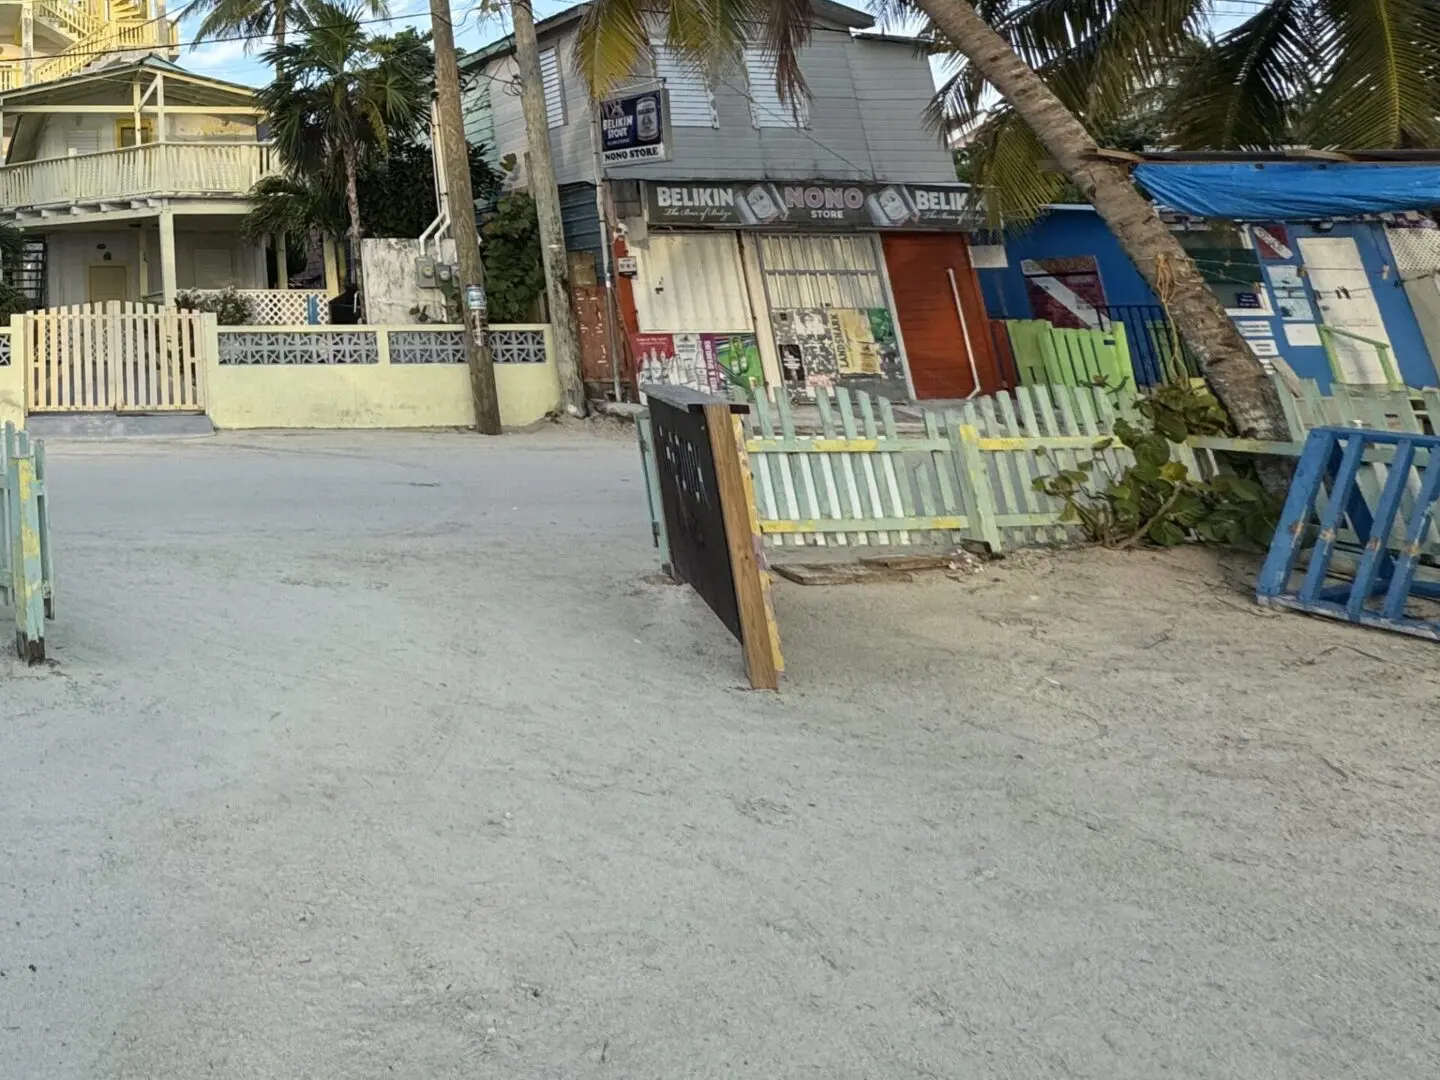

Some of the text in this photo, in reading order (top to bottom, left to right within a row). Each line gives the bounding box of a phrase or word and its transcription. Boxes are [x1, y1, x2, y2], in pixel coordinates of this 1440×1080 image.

[603, 115, 633, 130] BELIKIN
[607, 128, 628, 139] STOUT
[605, 147, 659, 162] NONO STORE
[656, 187, 734, 207] BELIKIN
[785, 186, 864, 209] NONO
[915, 190, 984, 211] BELIK
[811, 210, 844, 218] STORE
[830, 313, 849, 368] LANDSHARK
